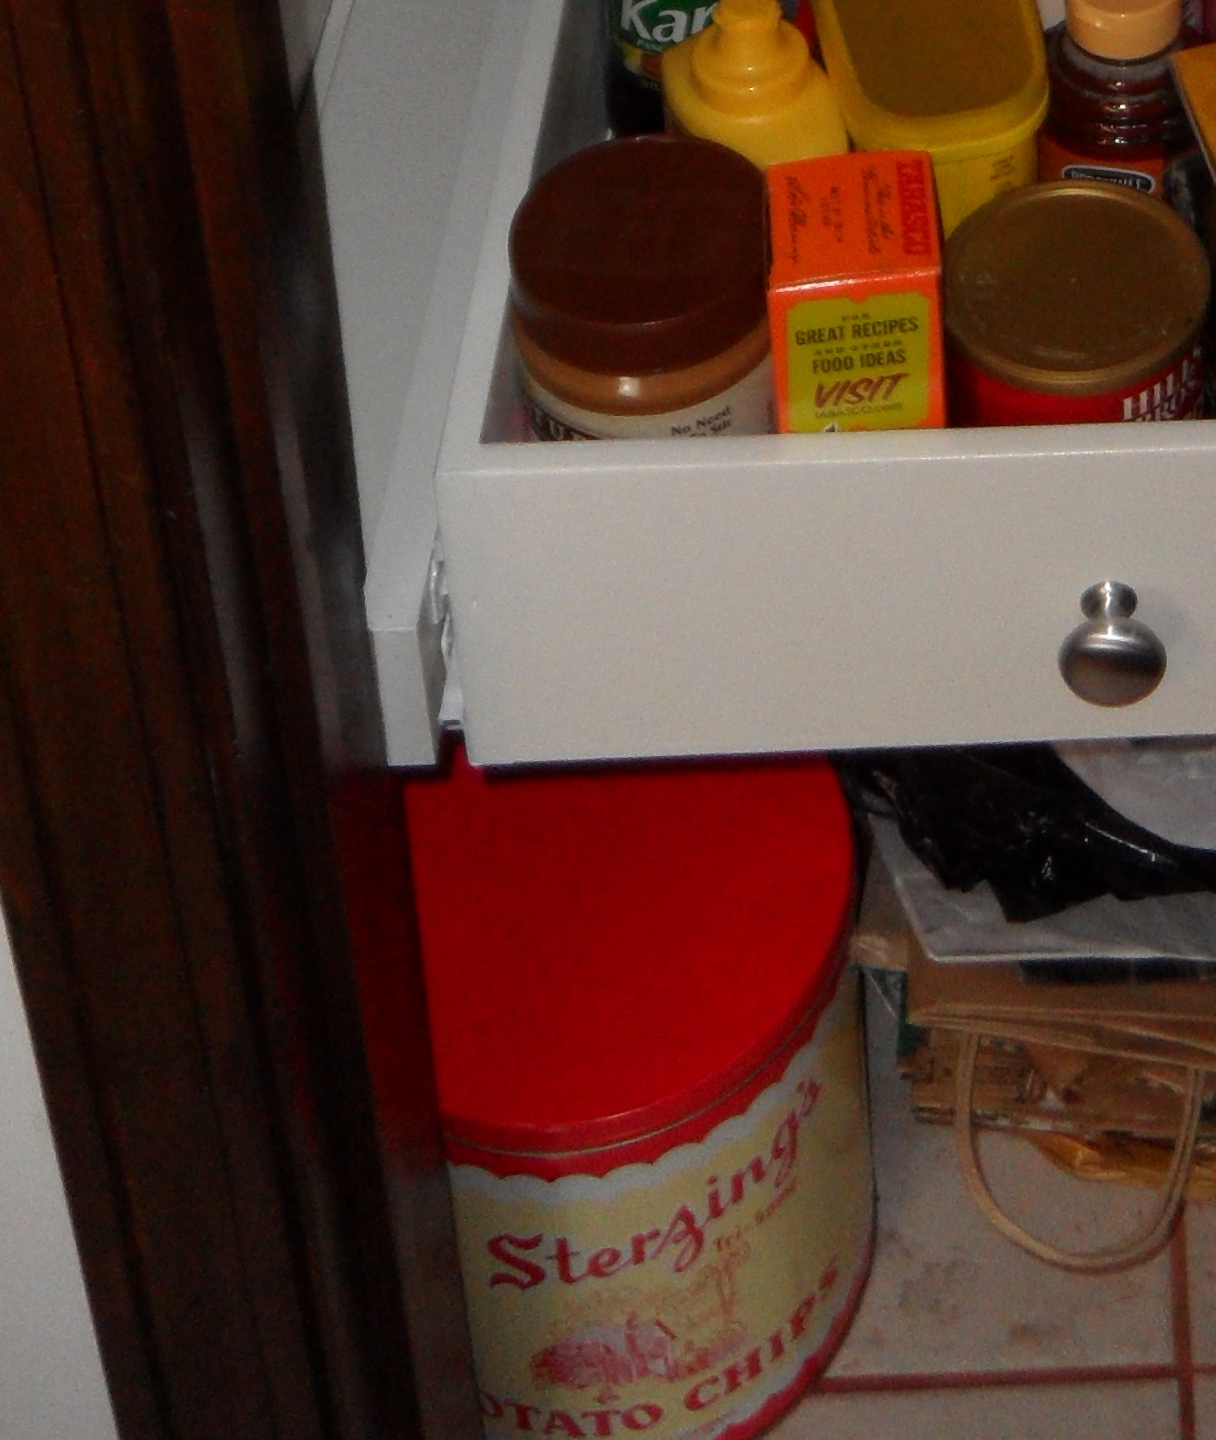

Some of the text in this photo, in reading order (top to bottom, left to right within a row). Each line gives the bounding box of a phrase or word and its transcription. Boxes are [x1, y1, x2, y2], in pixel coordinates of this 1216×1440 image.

[795, 316, 919, 346] GREAT RECIPES
[812, 348, 908, 375] FOOD IDEAS
[814, 371, 911, 409] VISIT
[671, 405, 731, 438] No Need
[486, 1077, 824, 1292] Sterzing's
